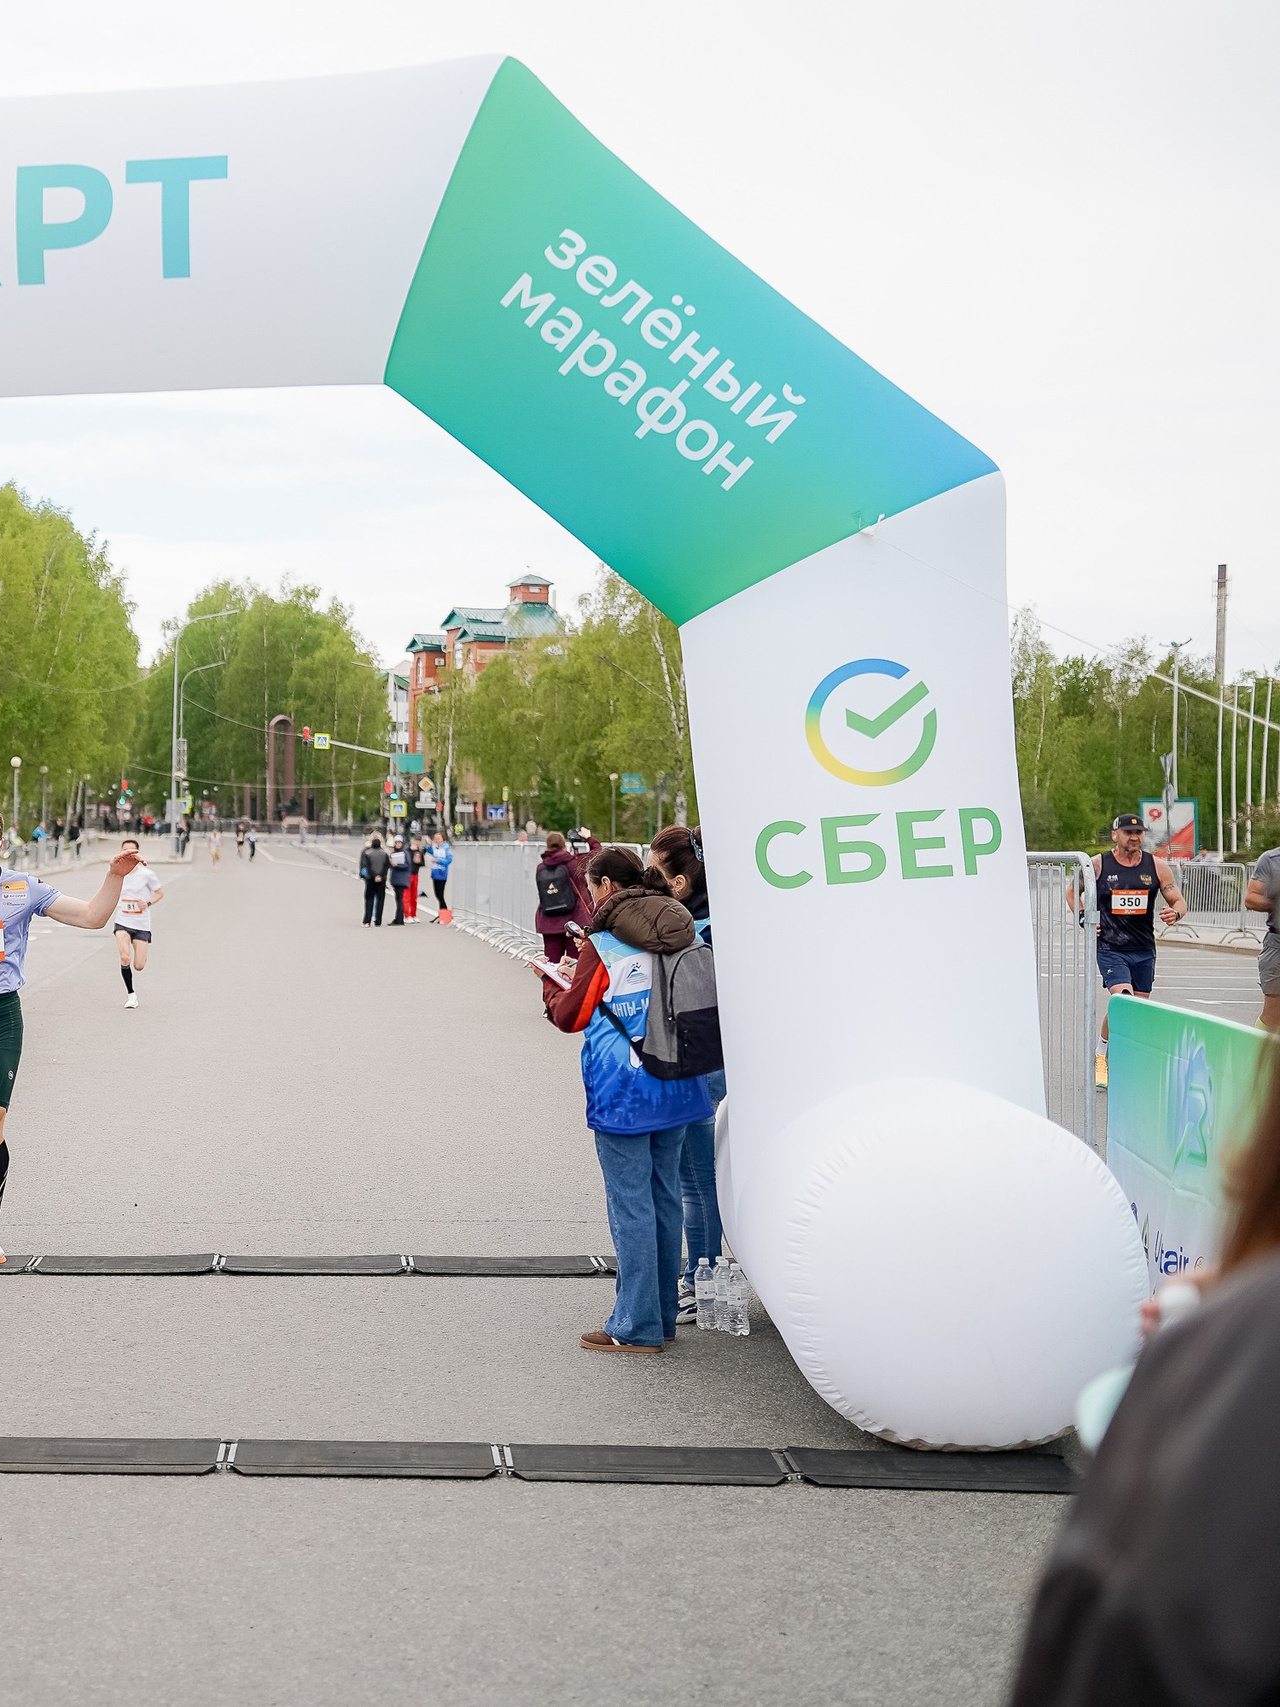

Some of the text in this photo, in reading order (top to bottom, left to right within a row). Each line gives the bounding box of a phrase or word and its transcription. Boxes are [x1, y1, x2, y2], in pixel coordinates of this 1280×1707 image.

[500, 272, 754, 491] марафон
[544, 228, 806, 444] зелёный
[755, 807, 1002, 889] СБЕР
[1119, 897, 1141, 907] 350
